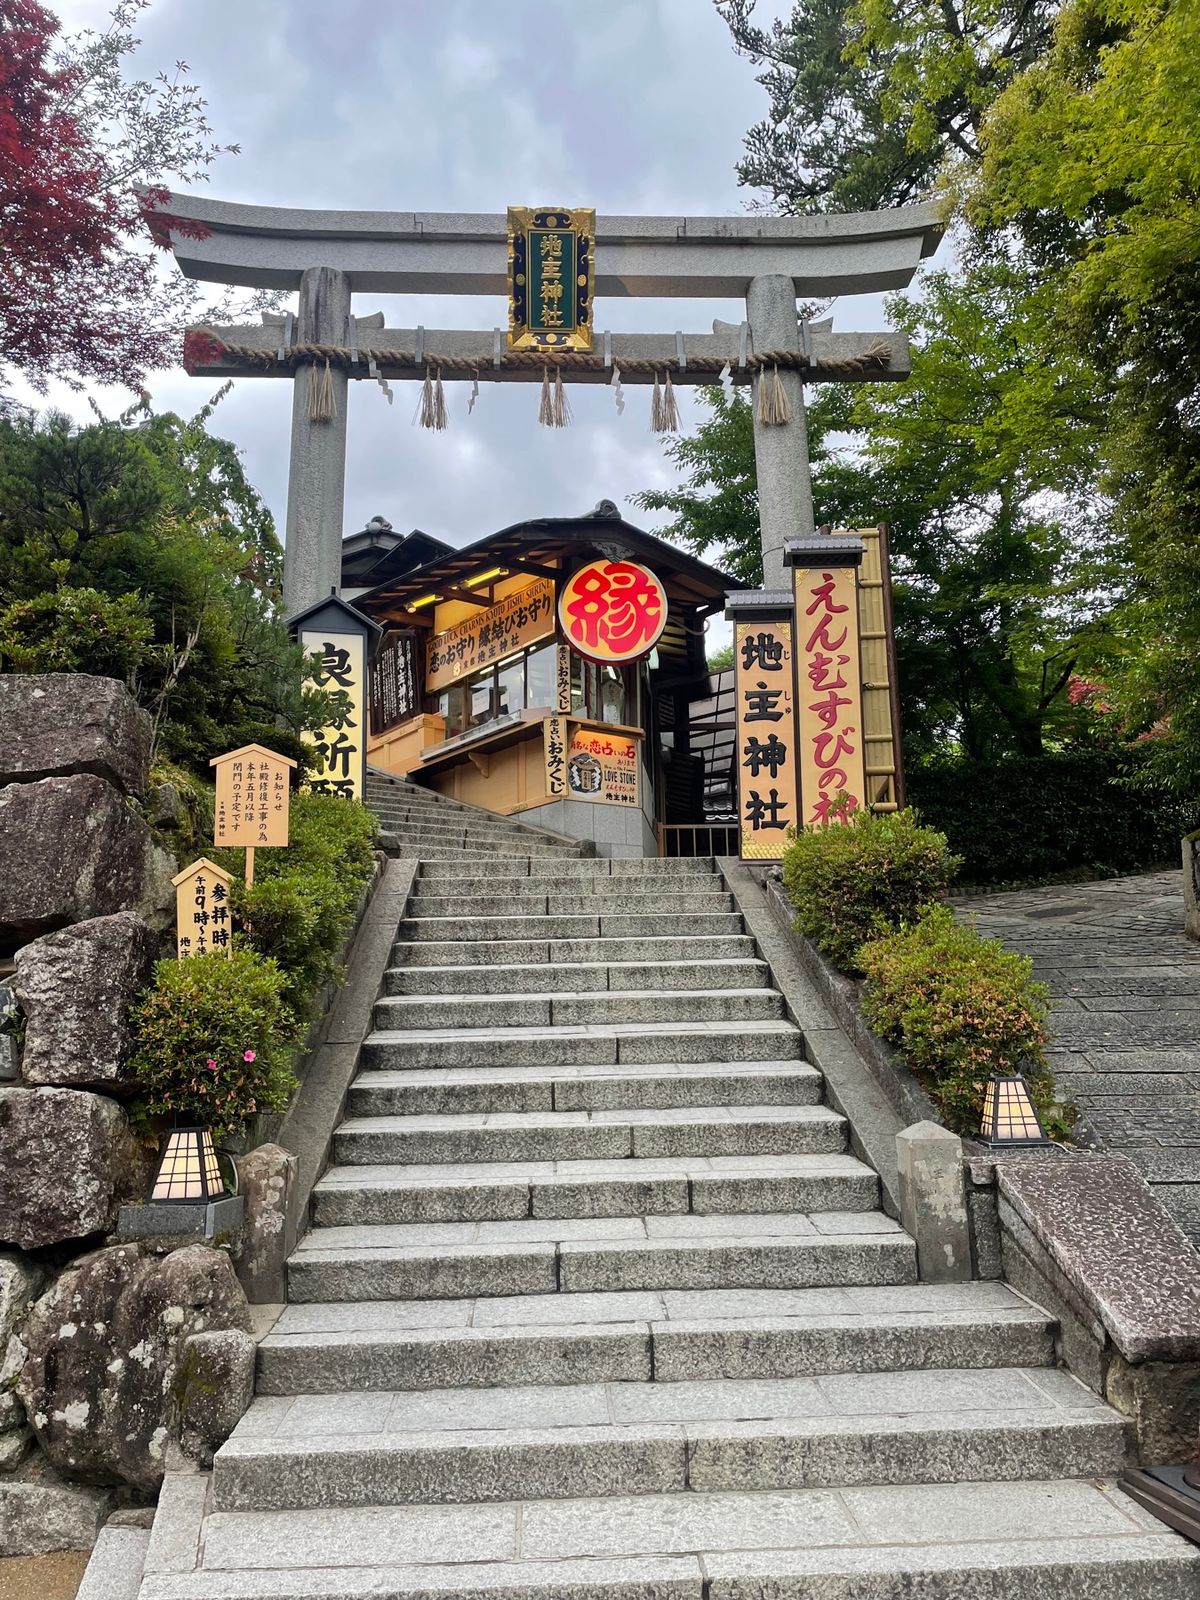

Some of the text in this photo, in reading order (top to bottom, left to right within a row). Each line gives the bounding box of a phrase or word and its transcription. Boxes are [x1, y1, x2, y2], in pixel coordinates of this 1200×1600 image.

[540, 234, 564, 327] 地主神社
[428, 579, 550, 653] GOOD LUCK CHARMS KYOTO JISHU SHRINE
[429, 634, 475, 675] 恋のお守り
[478, 593, 551, 649] 縁結びお守り
[566, 562, 661, 654] 縁
[477, 632, 520, 664] 地主神社
[741, 632, 790, 831] 地主神社
[805, 573, 858, 827] えんむすびの神
[245, 762, 256, 822] 本年五月以降
[273, 772, 284, 811] お知らせ
[547, 718, 566, 795] 恋占いおみくじ
[604, 771, 618, 783] LOVE
[619, 772, 636, 785] STONE
[605, 792, 635, 803] 地主神社
[210, 882, 229, 948] 参拝時
